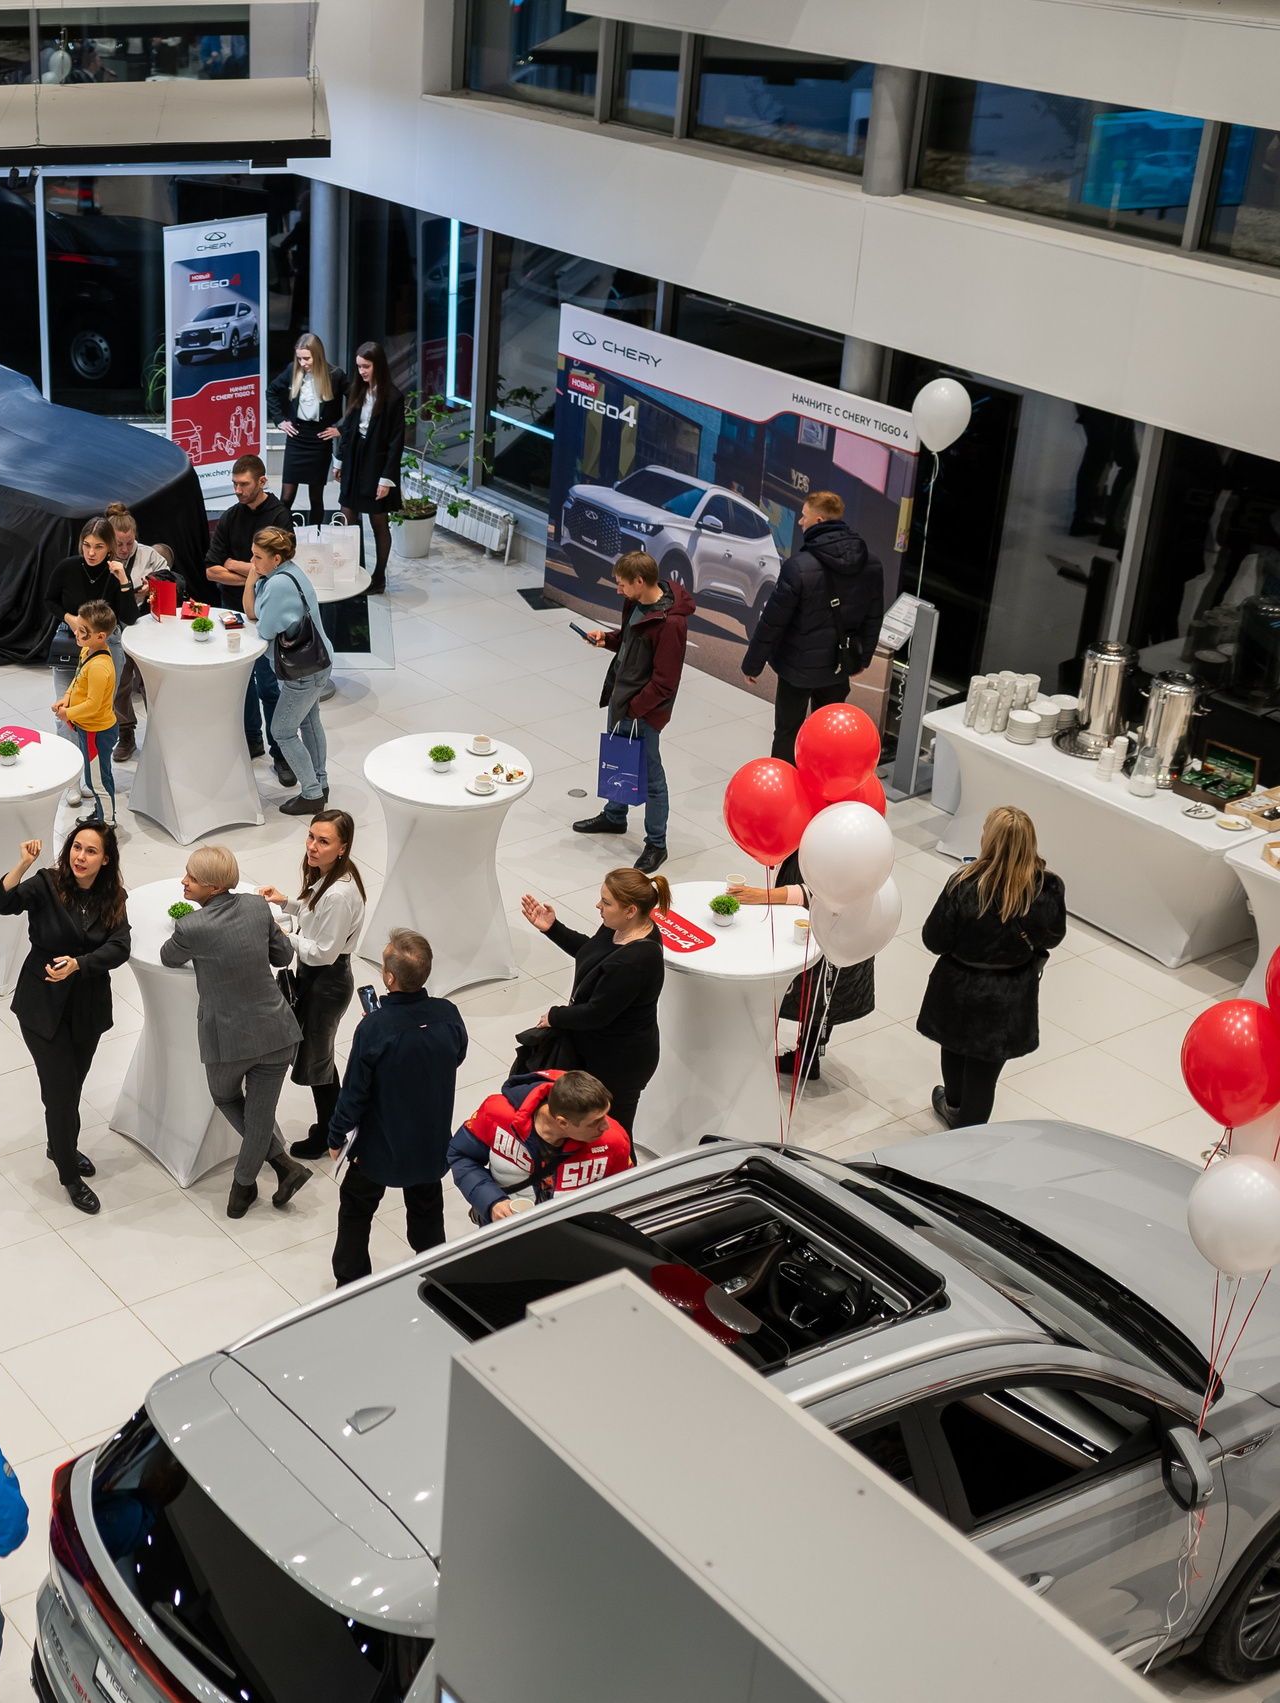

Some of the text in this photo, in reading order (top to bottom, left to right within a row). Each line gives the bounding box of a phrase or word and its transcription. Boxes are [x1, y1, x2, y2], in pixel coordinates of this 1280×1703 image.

[196, 241, 234, 252] CHERY
[602, 340, 662, 368] CHERY
[571, 378, 596, 393] НОВЫЙ
[216, 393, 235, 401] CHERY
[791, 392, 832, 414] НАЧНИТЕ
[842, 410, 871, 427] CHERY
[874, 419, 901, 437] TIGGO
[903, 430, 909, 440] 4
[790, 467, 810, 493] YES
[686, 932, 705, 945] ЭТОТ
[493, 1125, 532, 1174] RUS
